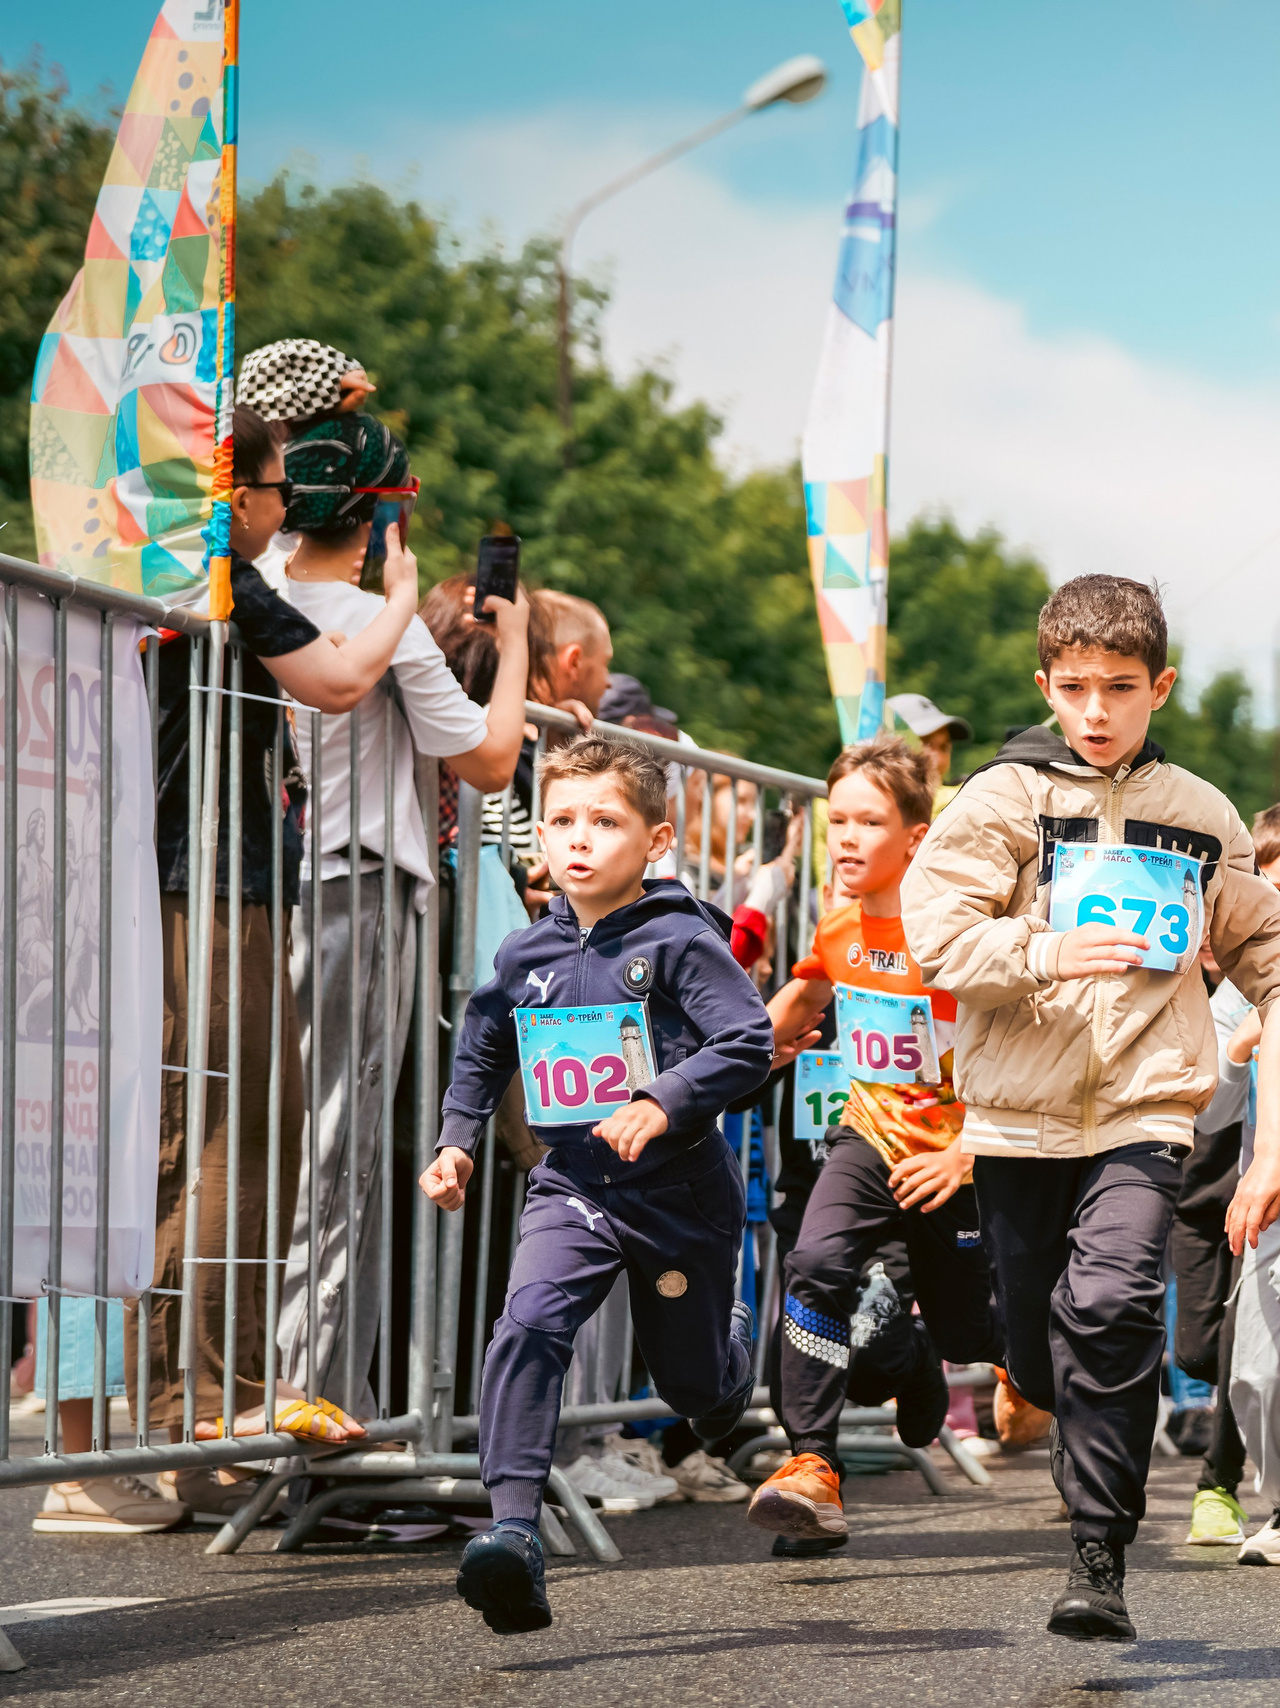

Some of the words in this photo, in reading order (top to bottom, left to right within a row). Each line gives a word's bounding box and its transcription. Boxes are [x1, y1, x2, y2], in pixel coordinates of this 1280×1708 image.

[1103, 855, 1132, 864] МАГАС
[1077, 894, 1190, 954] 673
[851, 1029, 923, 1071] 105
[532, 1055, 631, 1107] 102
